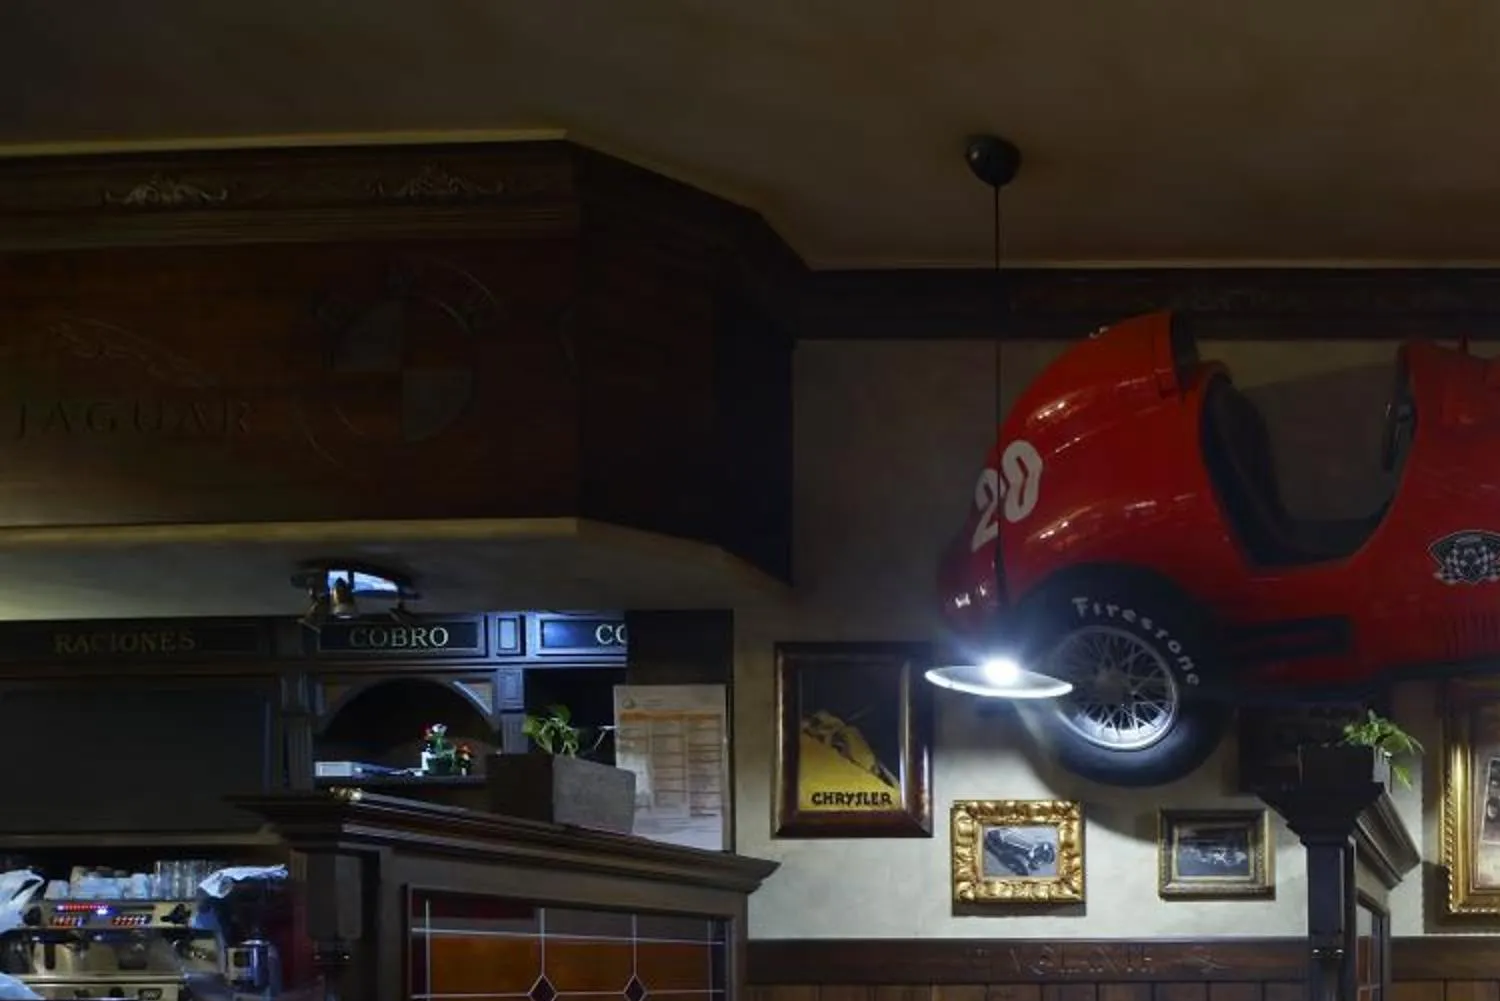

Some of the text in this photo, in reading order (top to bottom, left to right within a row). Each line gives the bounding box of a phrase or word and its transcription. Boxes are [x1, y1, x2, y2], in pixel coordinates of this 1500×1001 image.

[17, 399, 258, 439] JAGUAR
[971, 440, 1043, 552] 20
[53, 629, 196, 655] RACIONES
[349, 625, 450, 650] COBRO
[1071, 597, 1200, 687] Firestone
[811, 791, 893, 806] CHRYSLER
